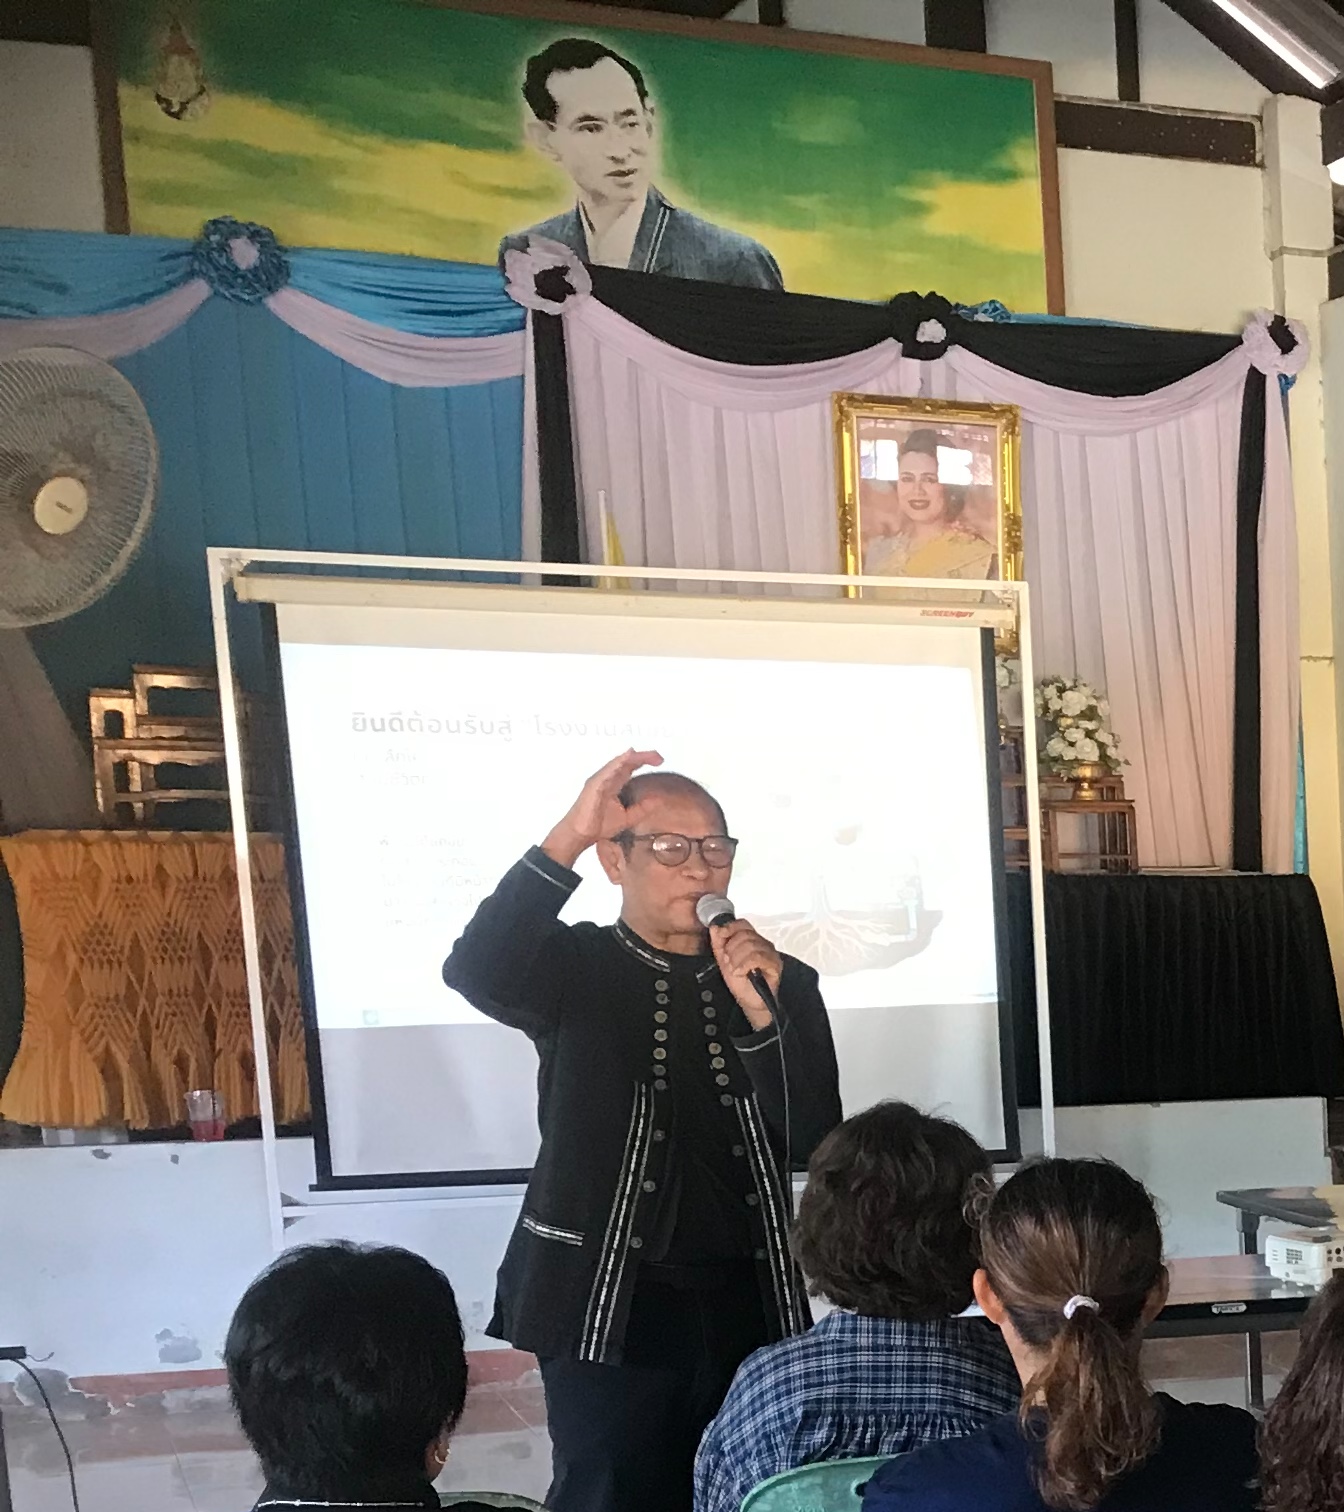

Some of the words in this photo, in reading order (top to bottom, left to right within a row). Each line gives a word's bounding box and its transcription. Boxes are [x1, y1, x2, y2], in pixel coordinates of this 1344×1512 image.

[351, 711, 513, 742] ยินดีต้อนรับสู่
